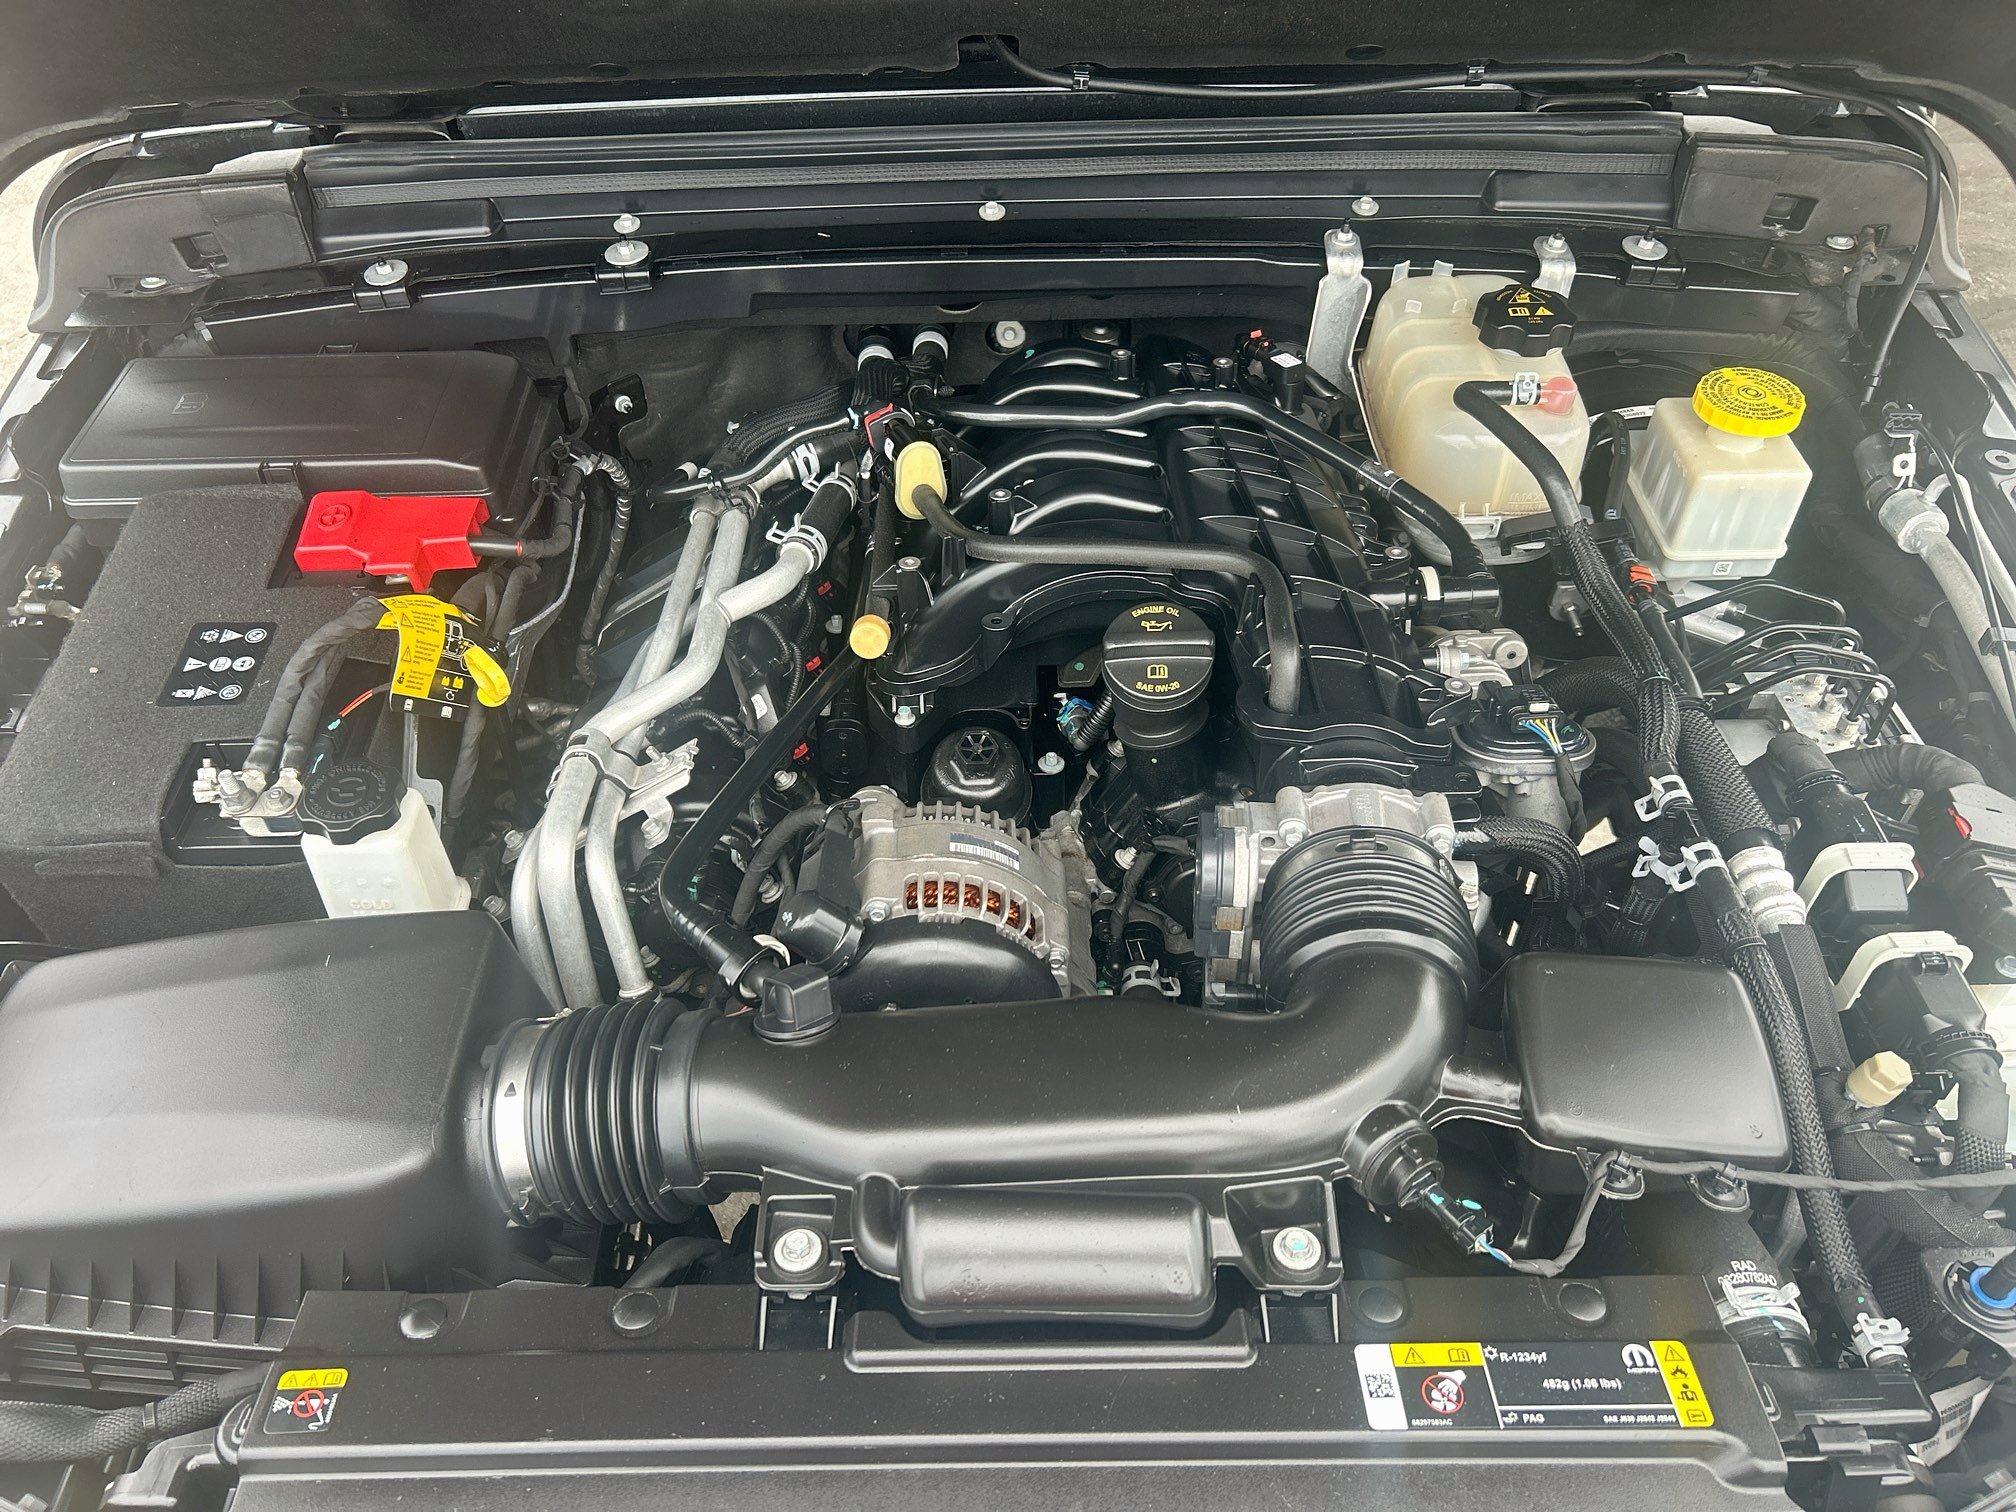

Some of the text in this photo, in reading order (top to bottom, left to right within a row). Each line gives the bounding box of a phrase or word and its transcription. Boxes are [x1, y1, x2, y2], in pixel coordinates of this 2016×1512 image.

[1131, 605, 1180, 618] ENGINE OIL
[1135, 681, 1180, 693] SAE 0W-20
[1730, 1260, 1757, 1272] RAD
[1499, 1351, 1547, 1365] R-1234yf
[1600, 1377, 1622, 1391] lbs)
[1522, 1413, 1545, 1424] PAG
